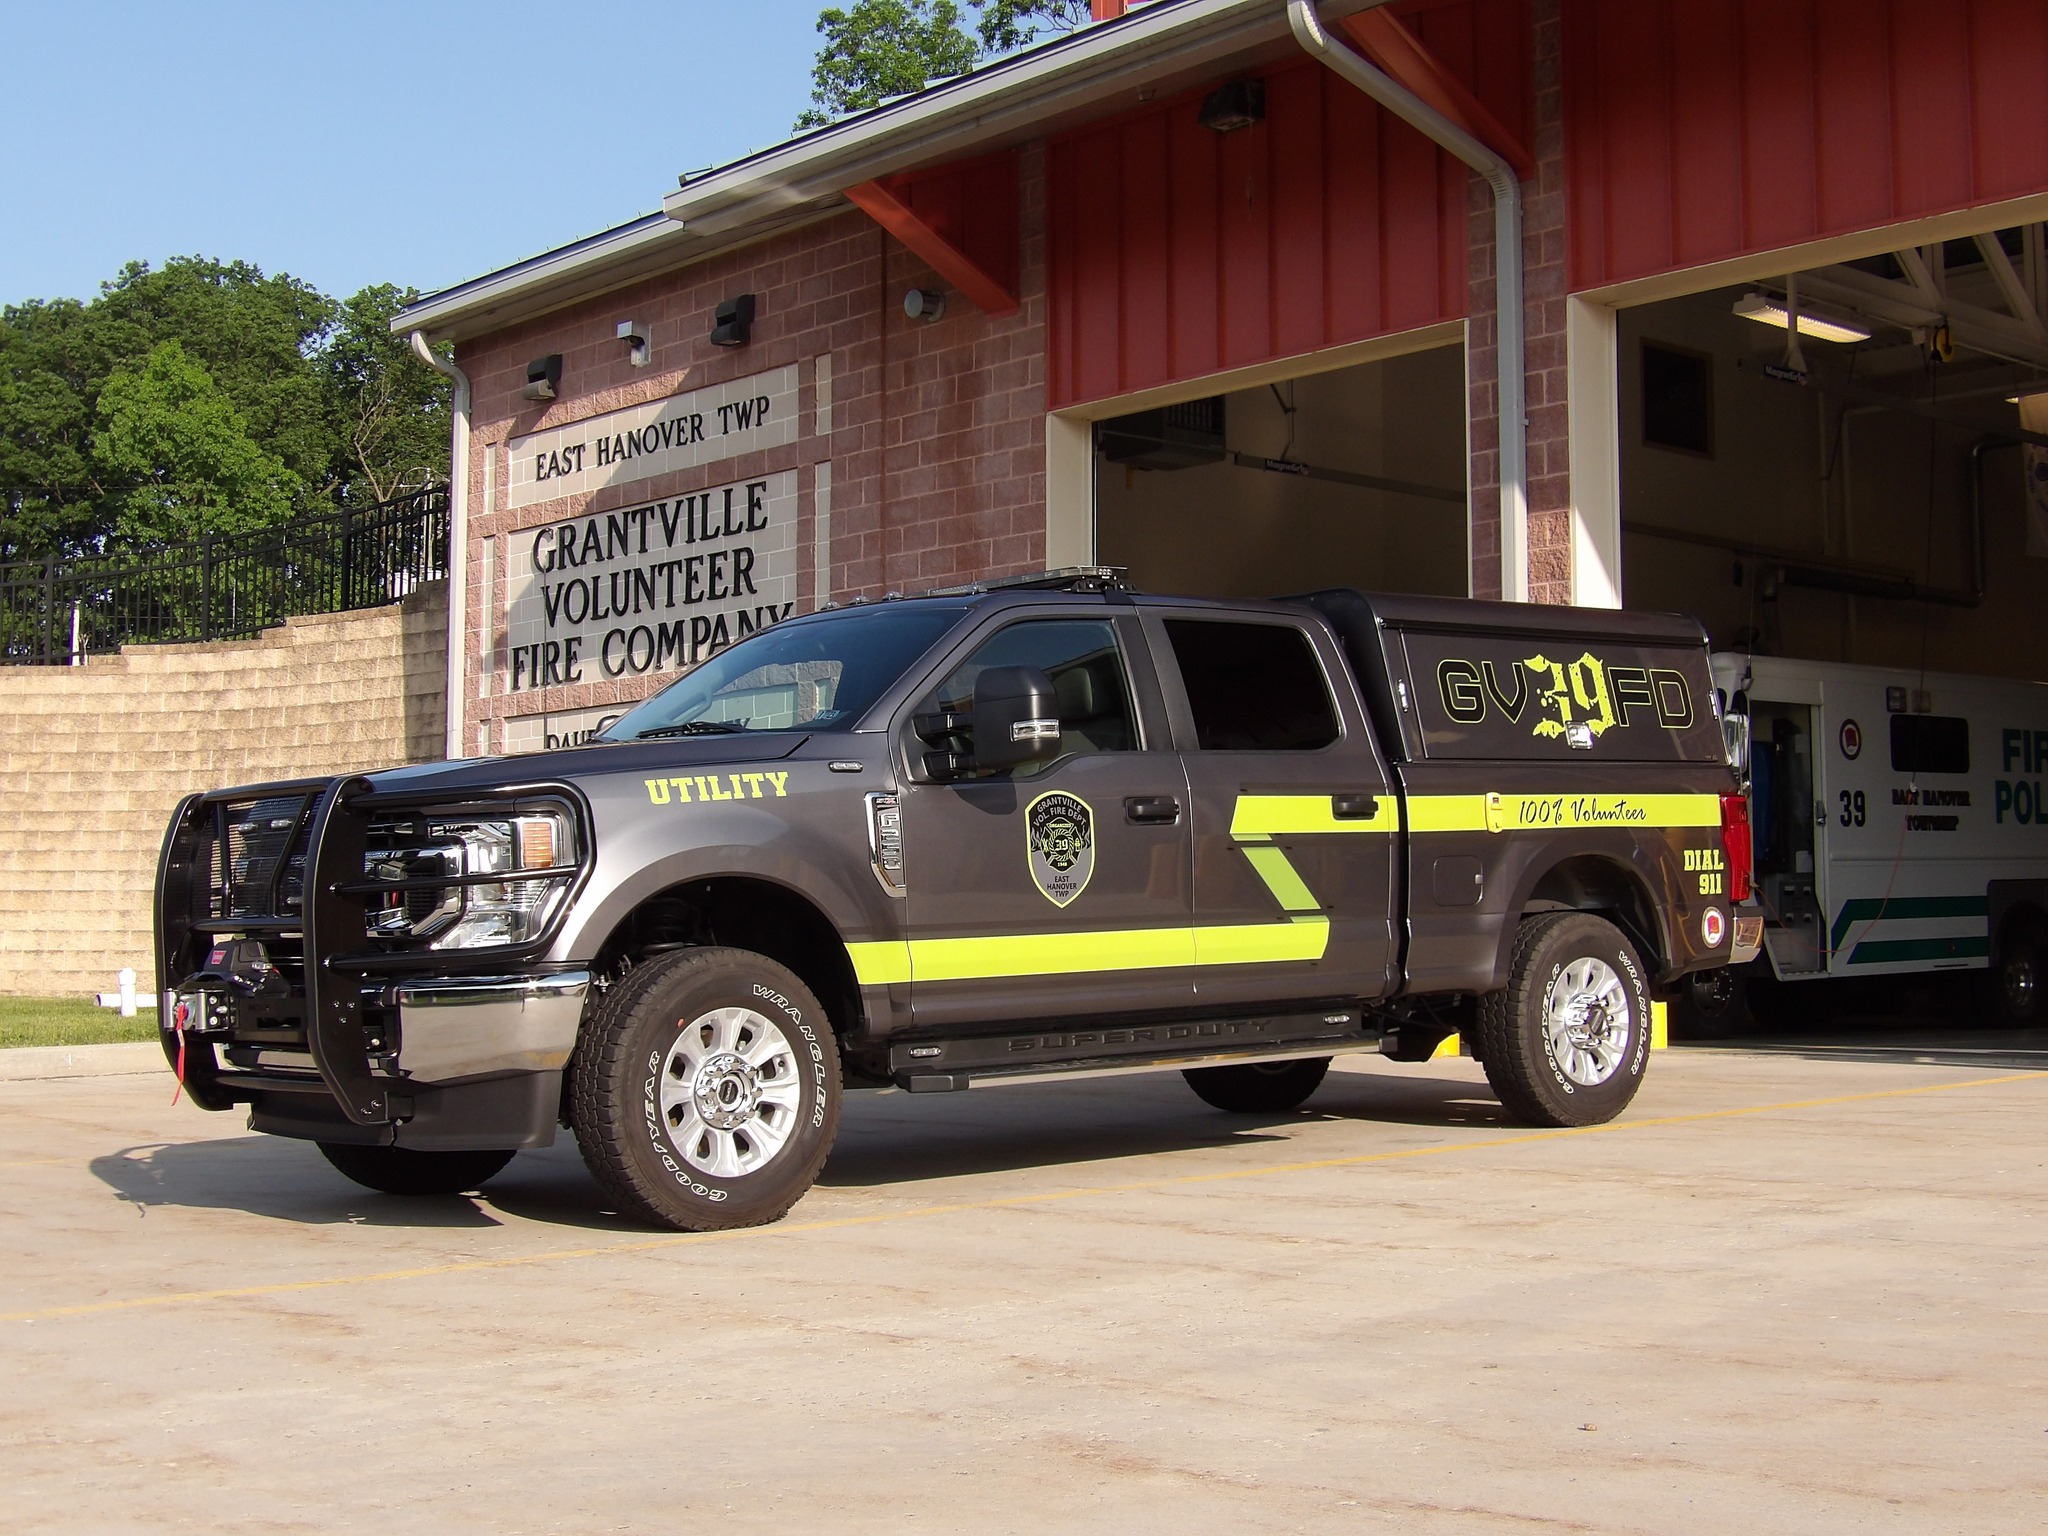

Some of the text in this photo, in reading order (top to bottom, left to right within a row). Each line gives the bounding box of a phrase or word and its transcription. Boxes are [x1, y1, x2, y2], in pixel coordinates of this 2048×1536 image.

[535, 395, 770, 482] EAST HANOVER TWP
[532, 481, 768, 573] GRANTVILLE
[540, 547, 757, 628] VOLUNTEER
[511, 636, 582, 690] FIRE
[644, 771, 789, 805] UTILITY
[1037, 797, 1083, 813] GRANTVILLE
[1050, 806, 1066, 816] FIRE
[1519, 797, 1647, 825] 100% Volunteer
[1839, 790, 1866, 827] 39
[1055, 838, 1068, 851] 39
[1684, 849, 1724, 871] DIAL
[1699, 873, 1722, 895] 911
[1619, 950, 1647, 1076] WRANGLER
[1008, 1019, 1271, 1051] SUPER DUTY
[753, 984, 826, 1127] WRANGLER
[645, 1051, 727, 1202] GOODYEAR
